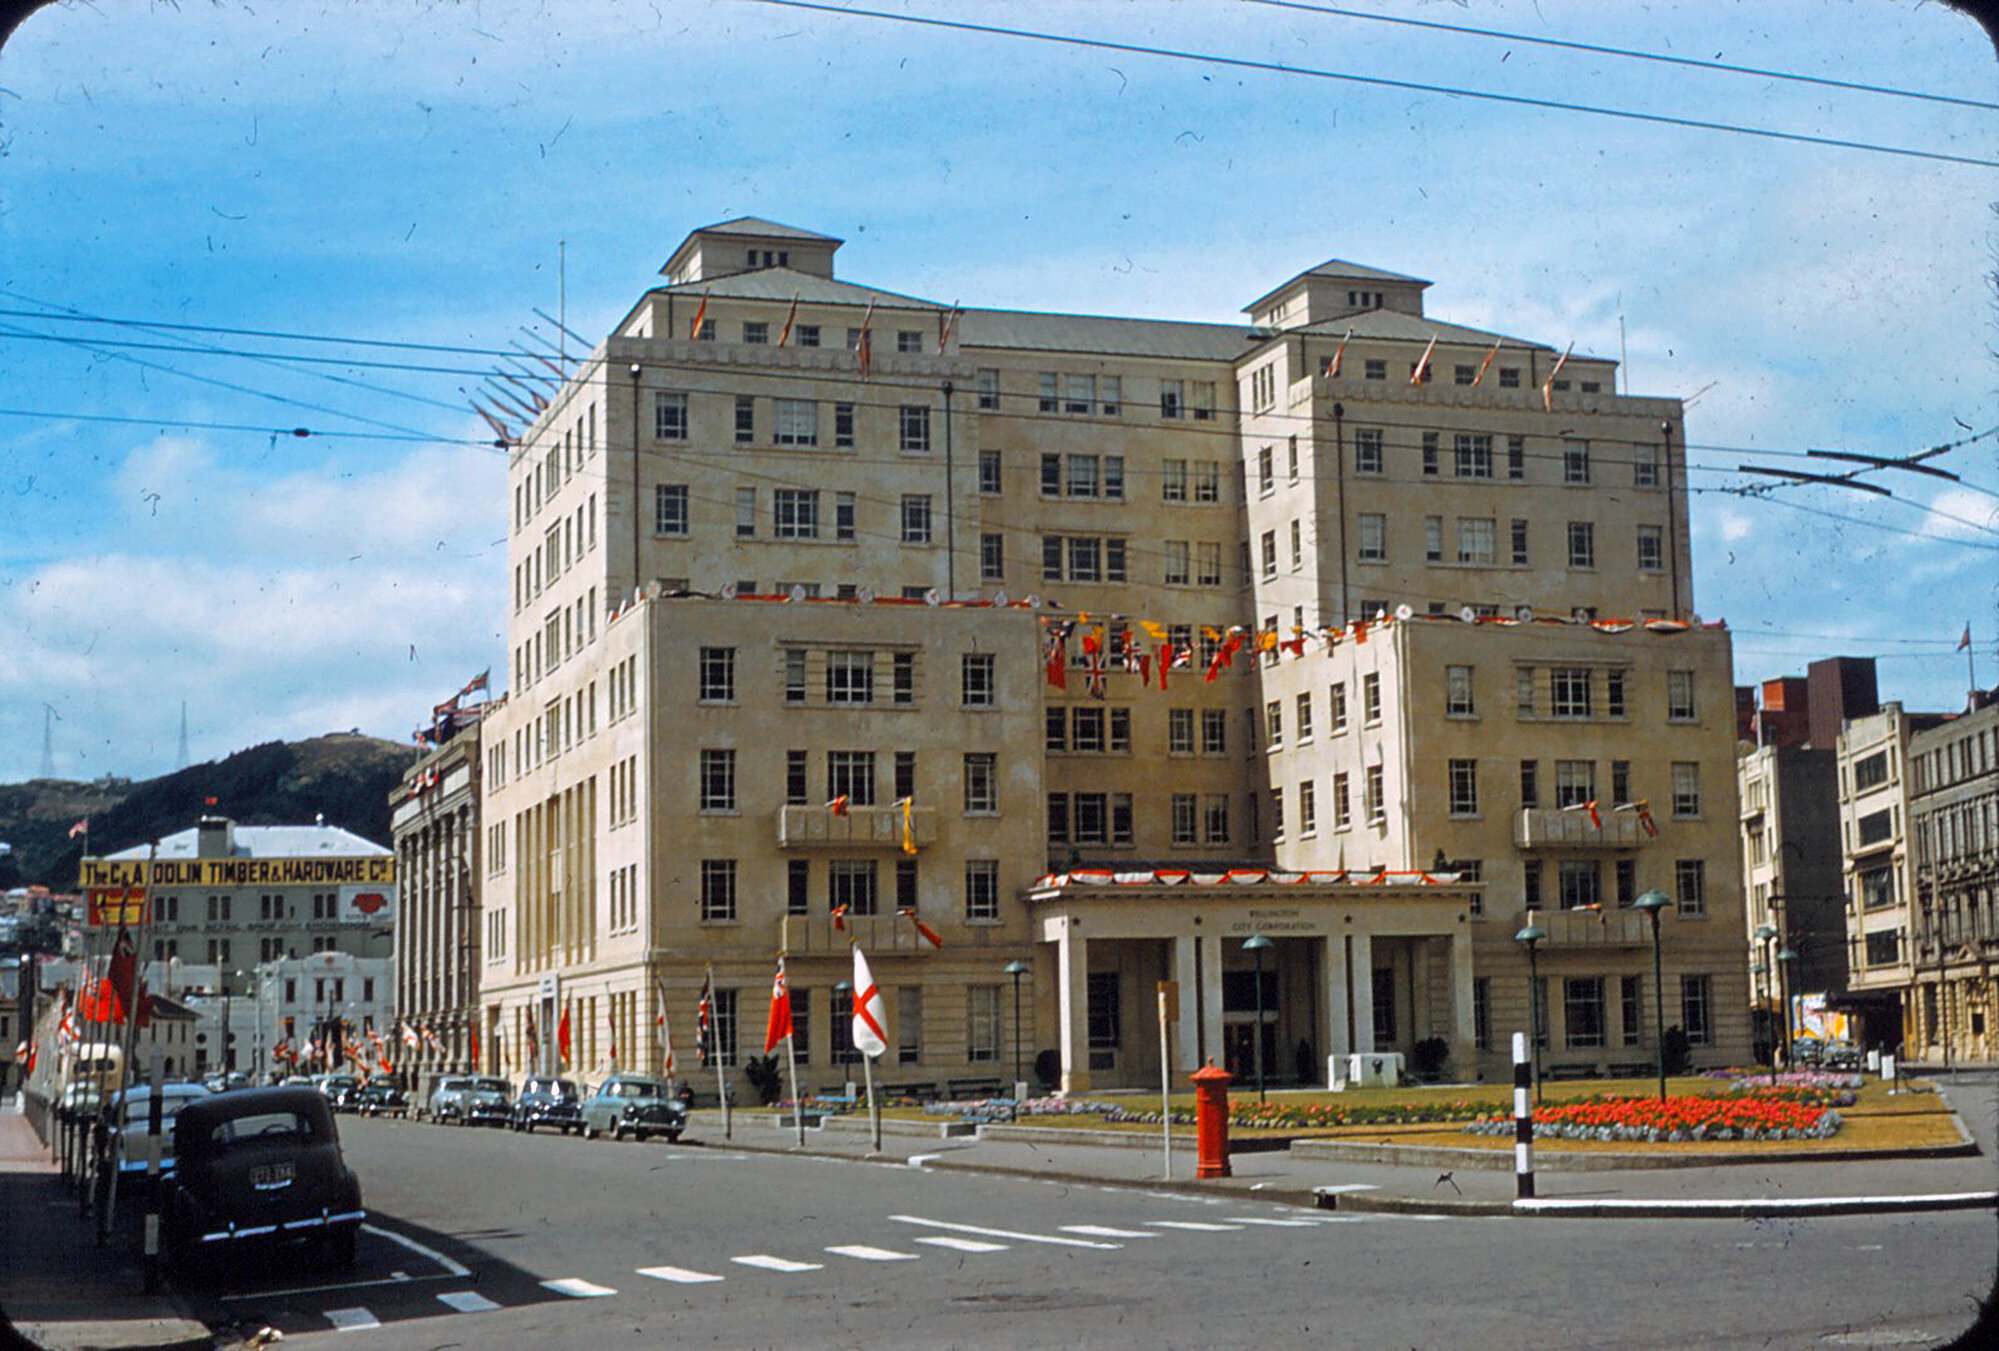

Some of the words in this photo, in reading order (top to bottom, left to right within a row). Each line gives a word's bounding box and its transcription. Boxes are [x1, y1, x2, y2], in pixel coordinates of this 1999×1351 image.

[85, 863, 108, 885] The
[110, 863, 121, 884] C
[133, 863, 143, 884] A
[208, 860, 269, 884] TIMBER
[271, 865, 281, 882] &
[282, 859, 364, 882] HARDWARE
